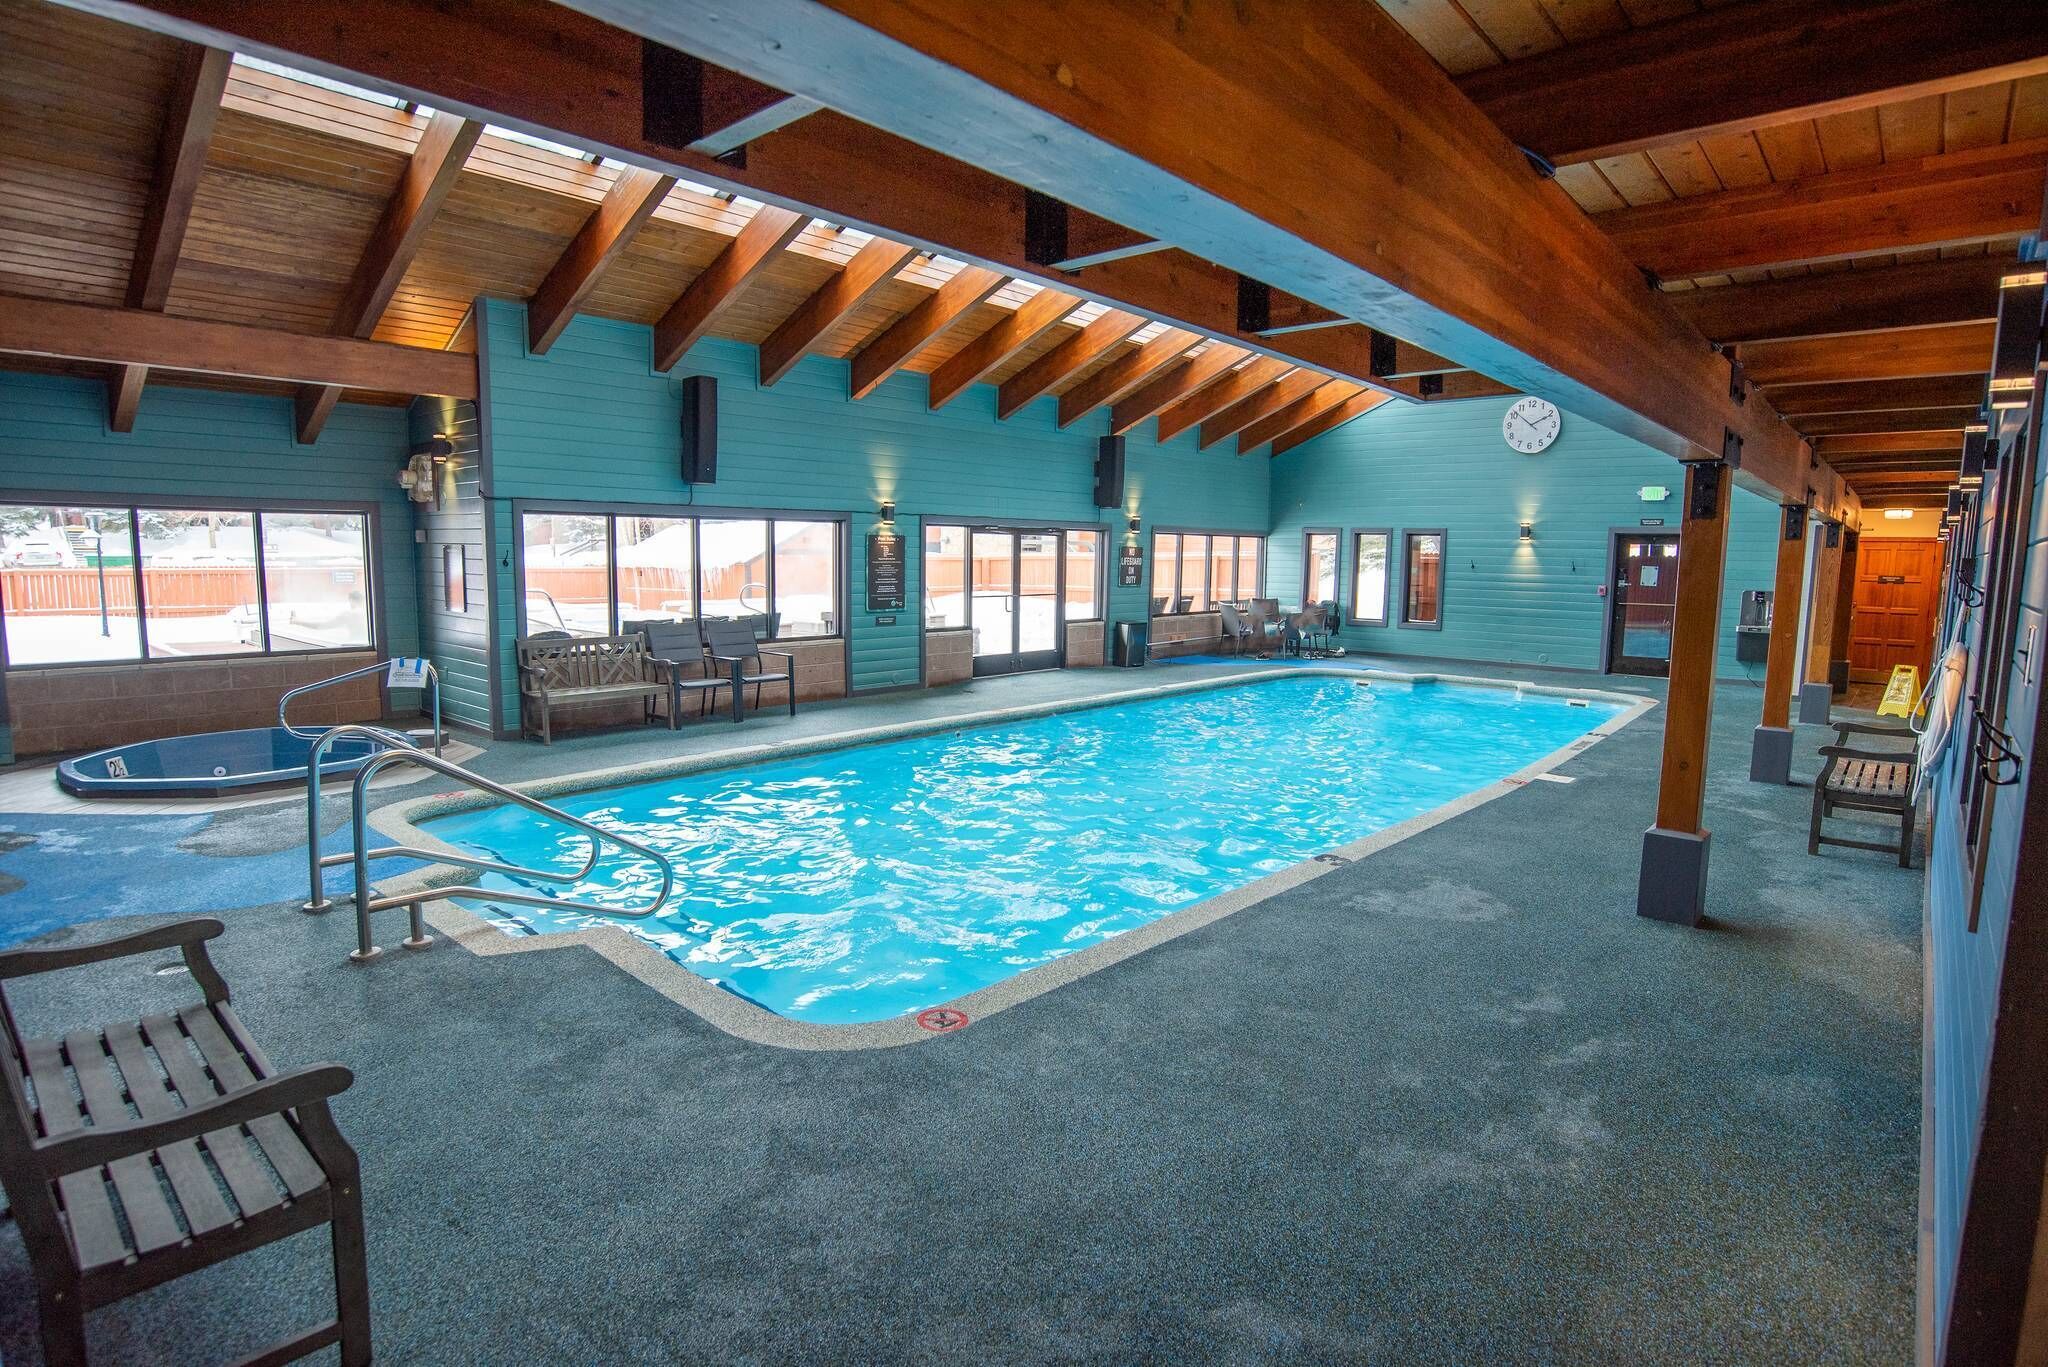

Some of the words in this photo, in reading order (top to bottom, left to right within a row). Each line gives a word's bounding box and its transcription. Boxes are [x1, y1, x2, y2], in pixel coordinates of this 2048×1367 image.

[1528, 400, 1537, 408] 12
[1510, 411, 1519, 420] 10
[1548, 409, 1554, 417] 2
[1551, 420, 1557, 429] 3
[1509, 432, 1514, 440] 8
[1517, 440, 1522, 448] 7
[1527, 442, 1532, 450] 6
[1538, 439, 1543, 447] 5
[1125, 576, 1137, 584] DUTY
